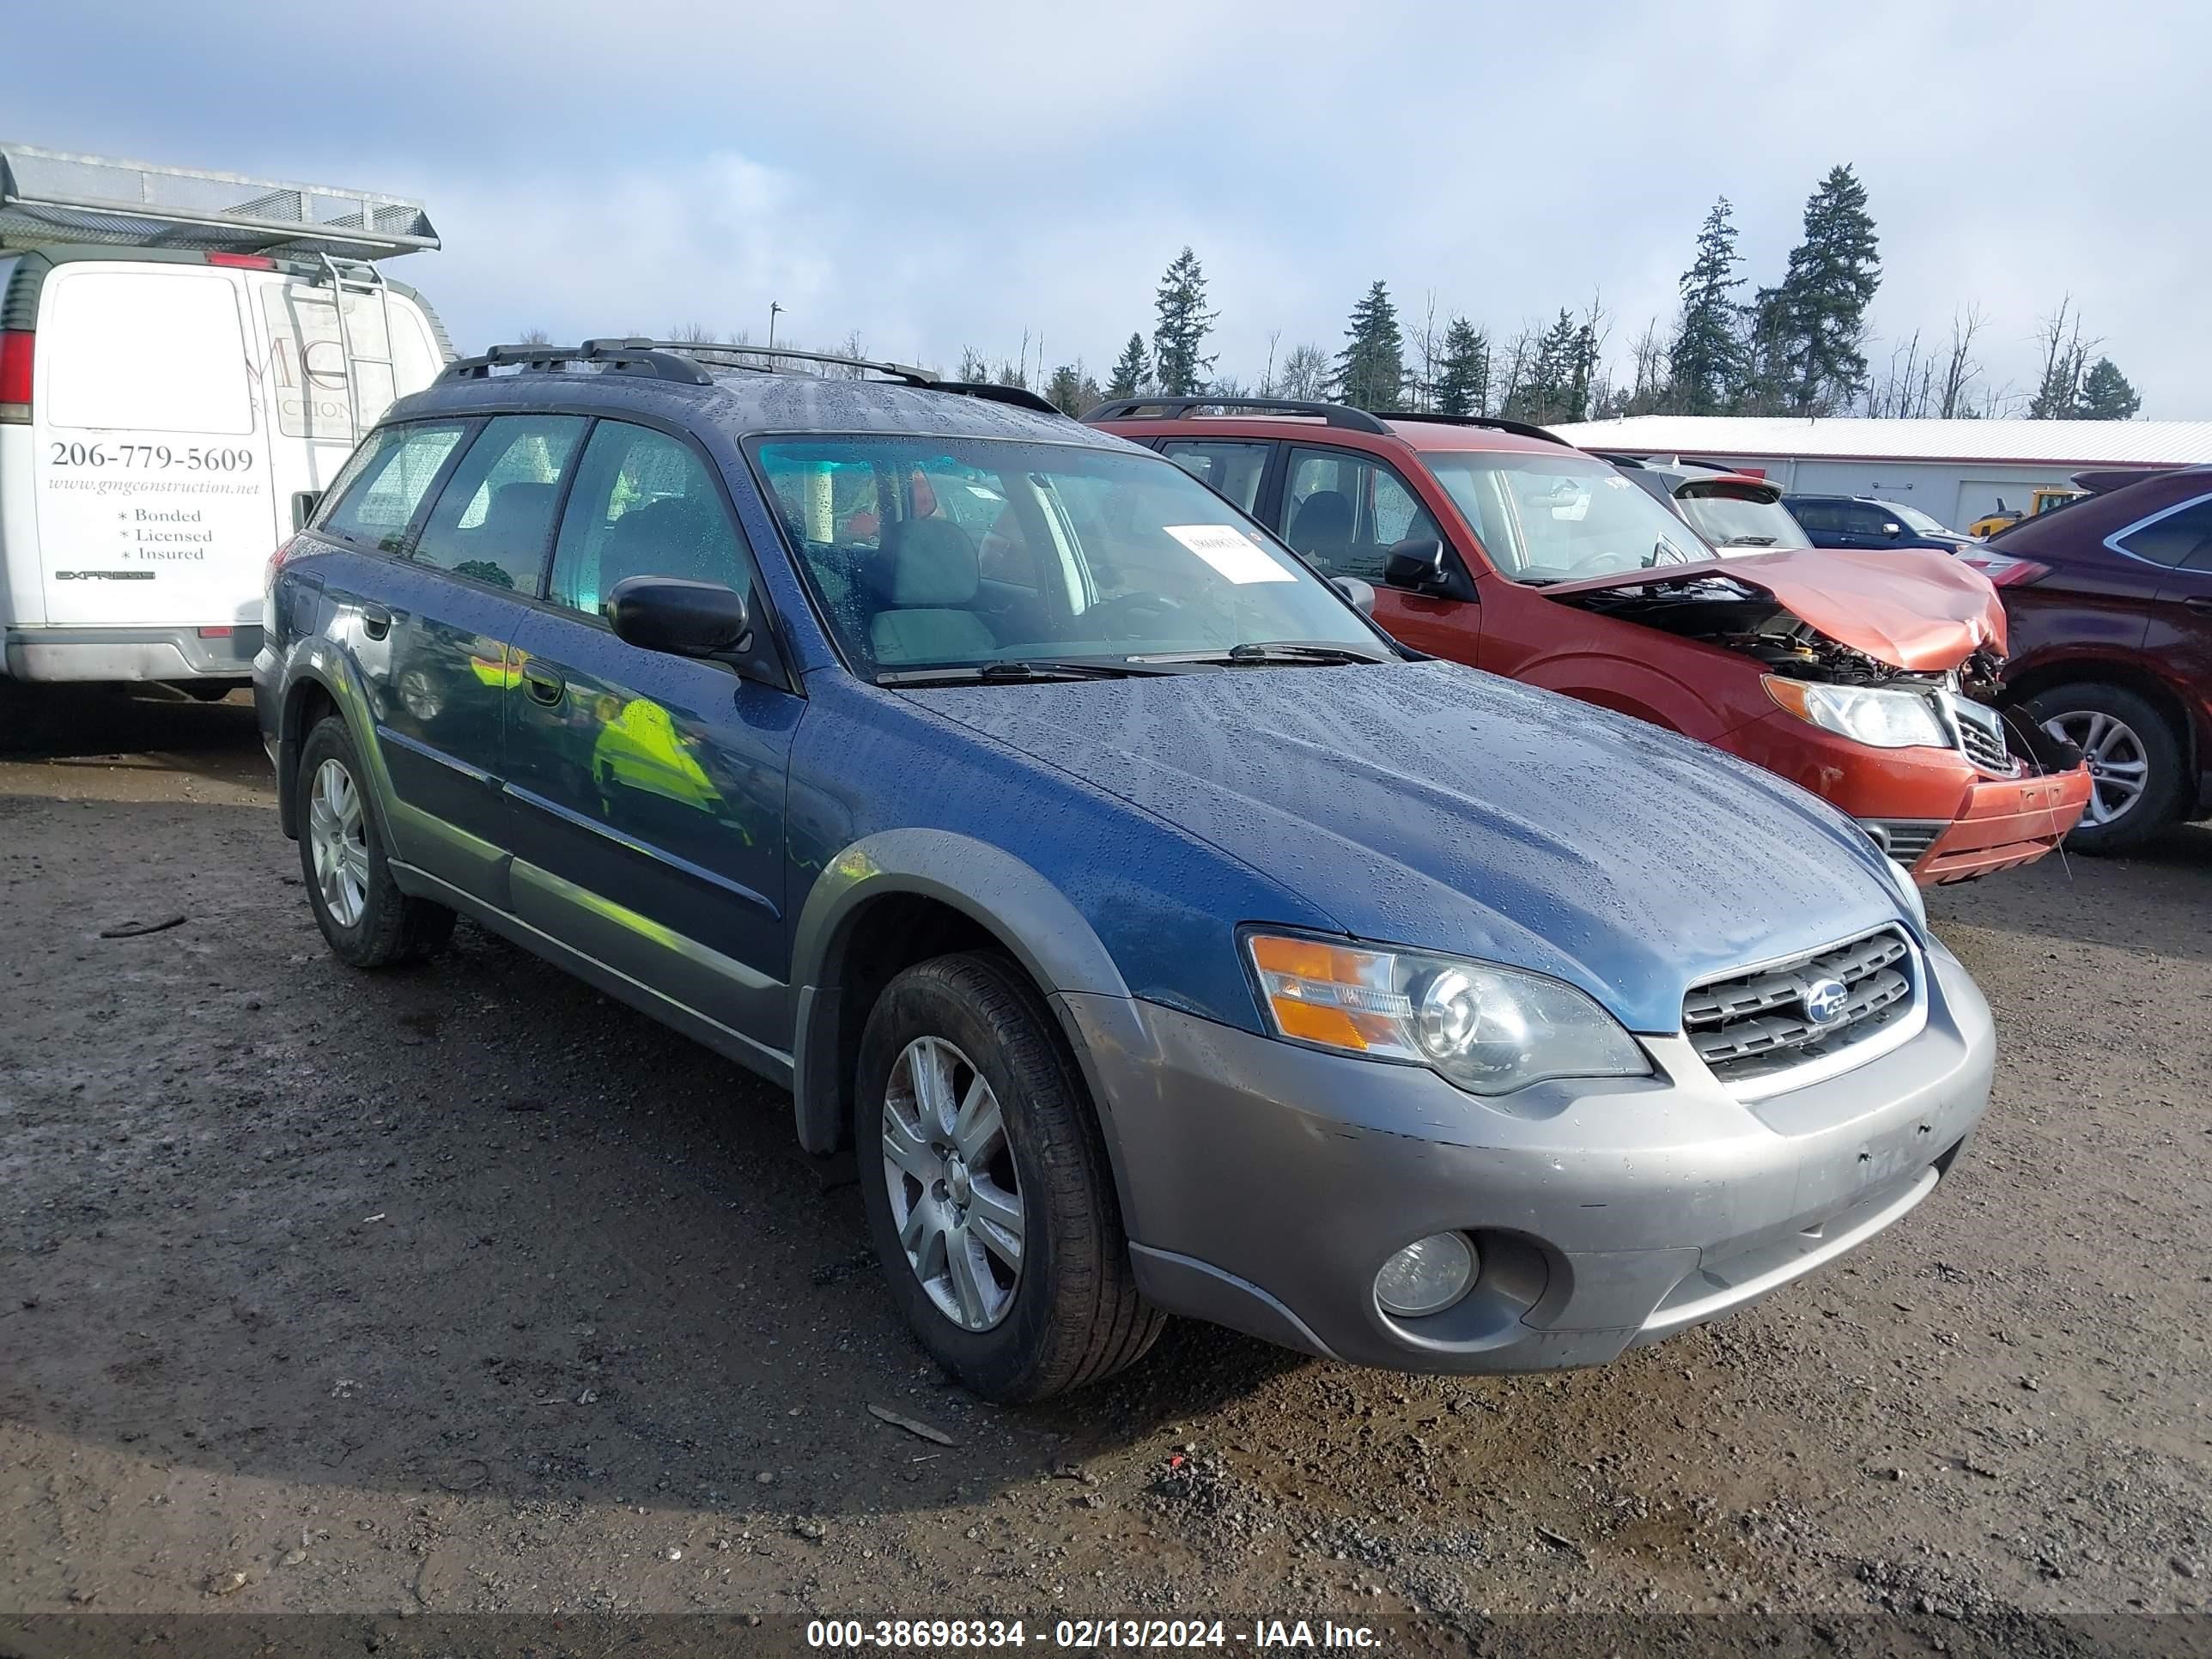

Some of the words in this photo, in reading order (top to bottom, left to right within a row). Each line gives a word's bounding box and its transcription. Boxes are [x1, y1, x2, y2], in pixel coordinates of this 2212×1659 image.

[51, 441, 253, 472] 206-779-5609
[49, 477, 261, 496] www.gmgconstruction.net
[135, 508, 202, 522] Bonded
[136, 528, 212, 543] Licensed
[138, 547, 204, 560] Insured
[55, 570, 156, 580] EXPRESS
